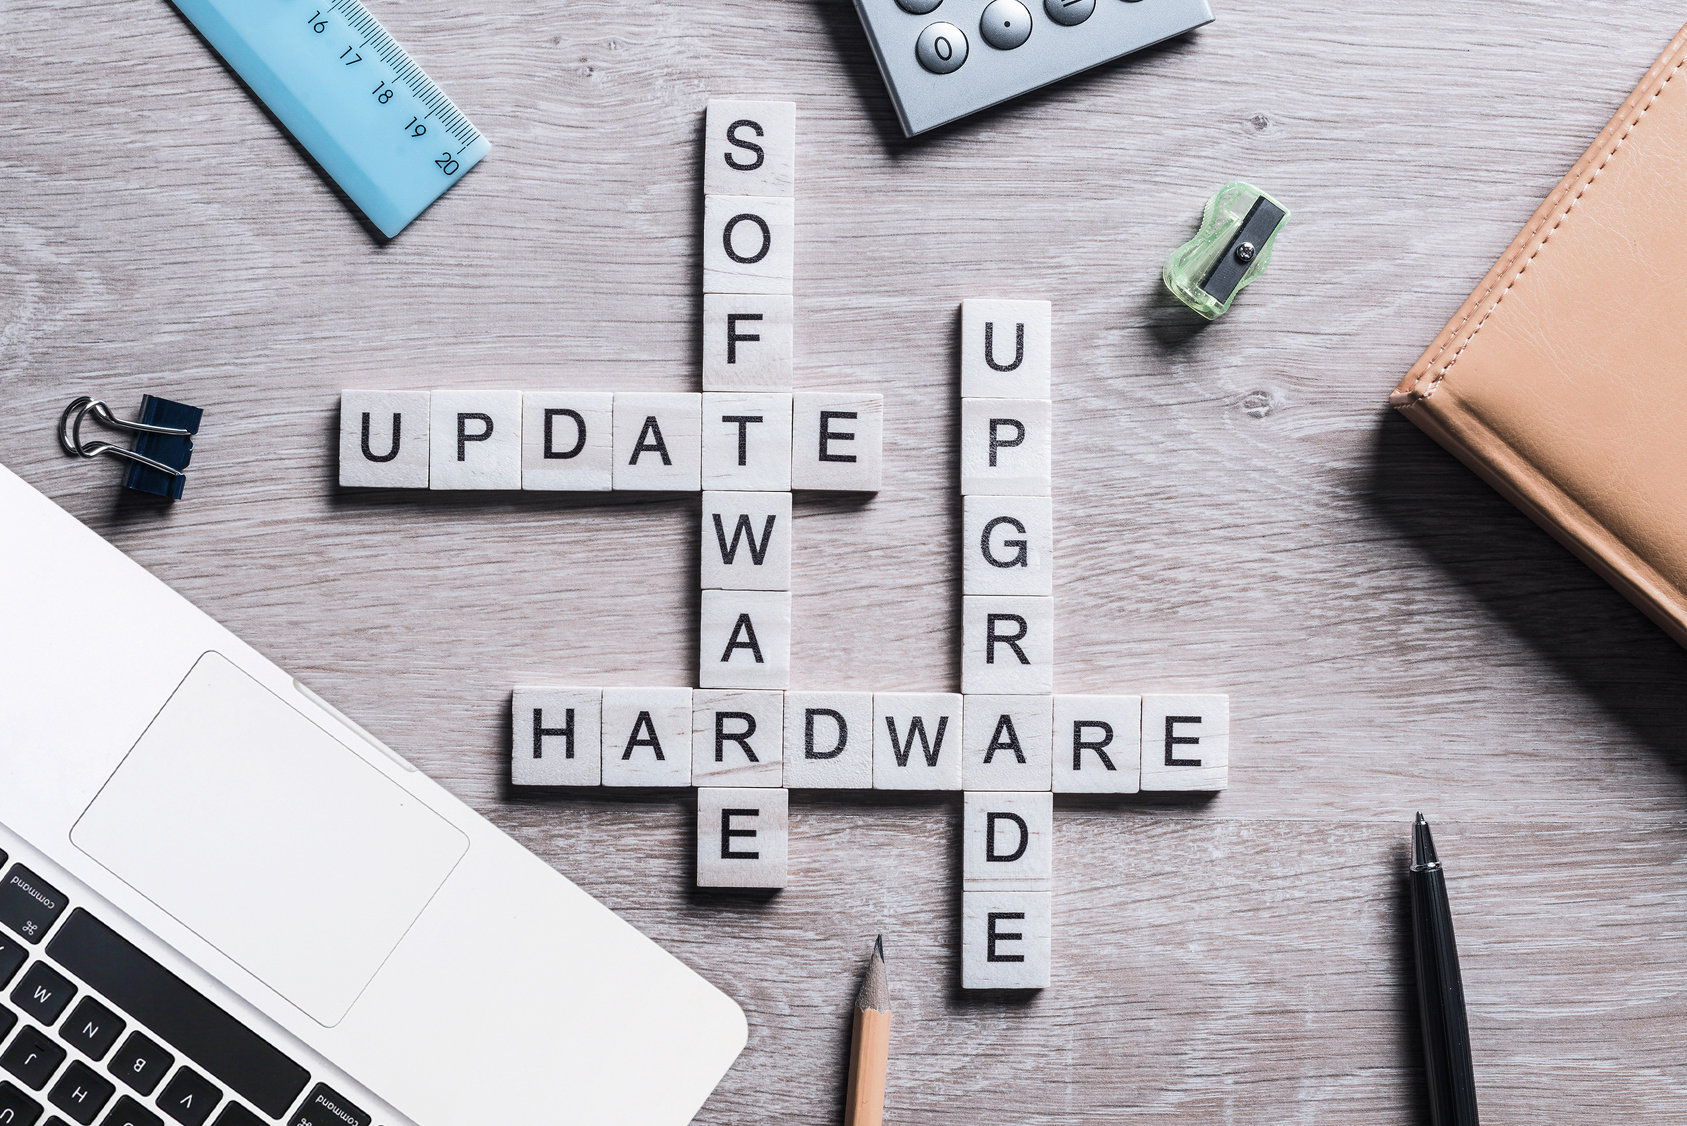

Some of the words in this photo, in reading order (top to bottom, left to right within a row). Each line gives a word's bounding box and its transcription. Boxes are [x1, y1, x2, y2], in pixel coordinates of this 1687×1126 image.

[308, 10, 328, 33] 16
[340, 46, 362, 66] 17
[934, 36, 952, 61] 0
[372, 81, 394, 104] 18
[404, 116, 427, 138] 19
[435, 152, 459, 175] 20
[360, 408, 858, 466] UPDATE
[712, 119, 776, 860] SOFTWARE
[980, 322, 1031, 963] UPGRADE
[532, 707, 1201, 771] HARDWARE
[10, 875, 56, 910] command
[33, 985, 52, 1003] M
[82, 1021, 99, 1038] N
[24, 1053, 37, 1065] J
[133, 1058, 147, 1073] B
[71, 1086, 88, 1103] H
[179, 1094, 193, 1109] V
[315, 1094, 359, 1126] command
